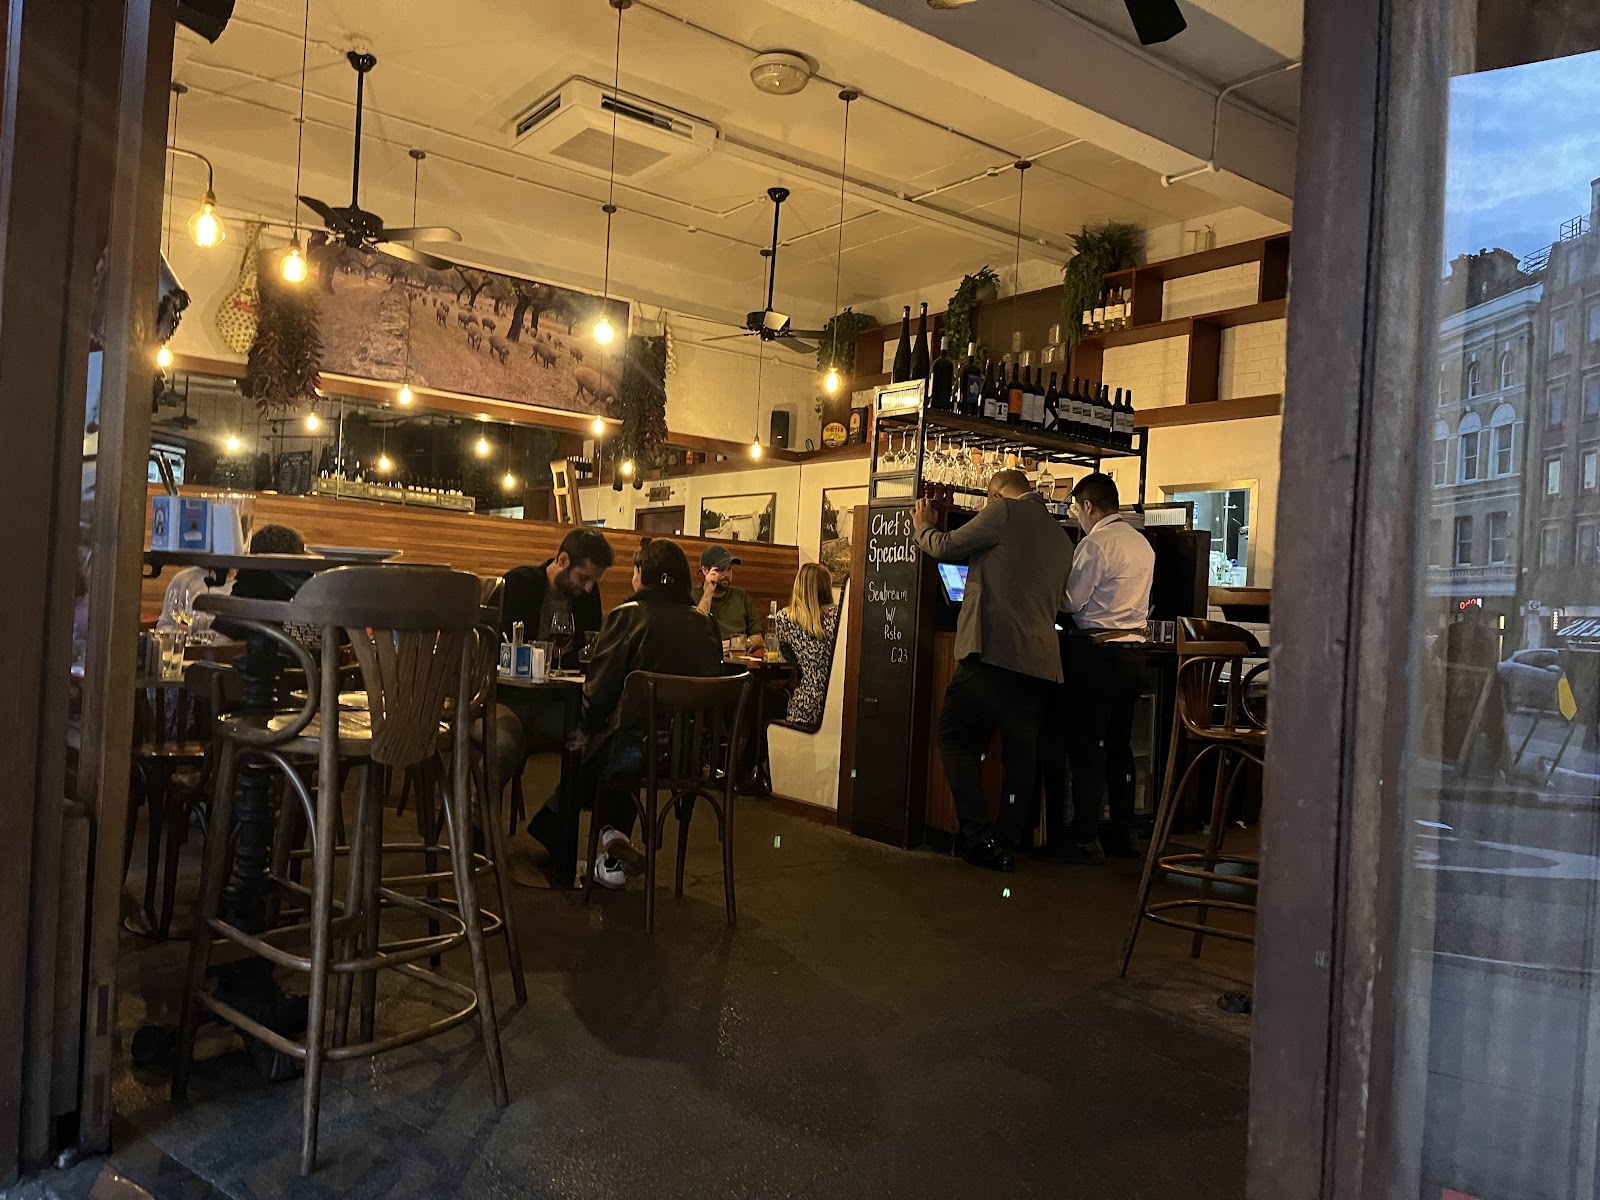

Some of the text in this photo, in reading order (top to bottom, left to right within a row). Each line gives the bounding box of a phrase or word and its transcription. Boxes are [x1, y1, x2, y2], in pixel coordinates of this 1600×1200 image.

[871, 510, 911, 536] Chef's
[868, 537, 916, 572] Specials
[867, 581, 908, 606] Seabream
